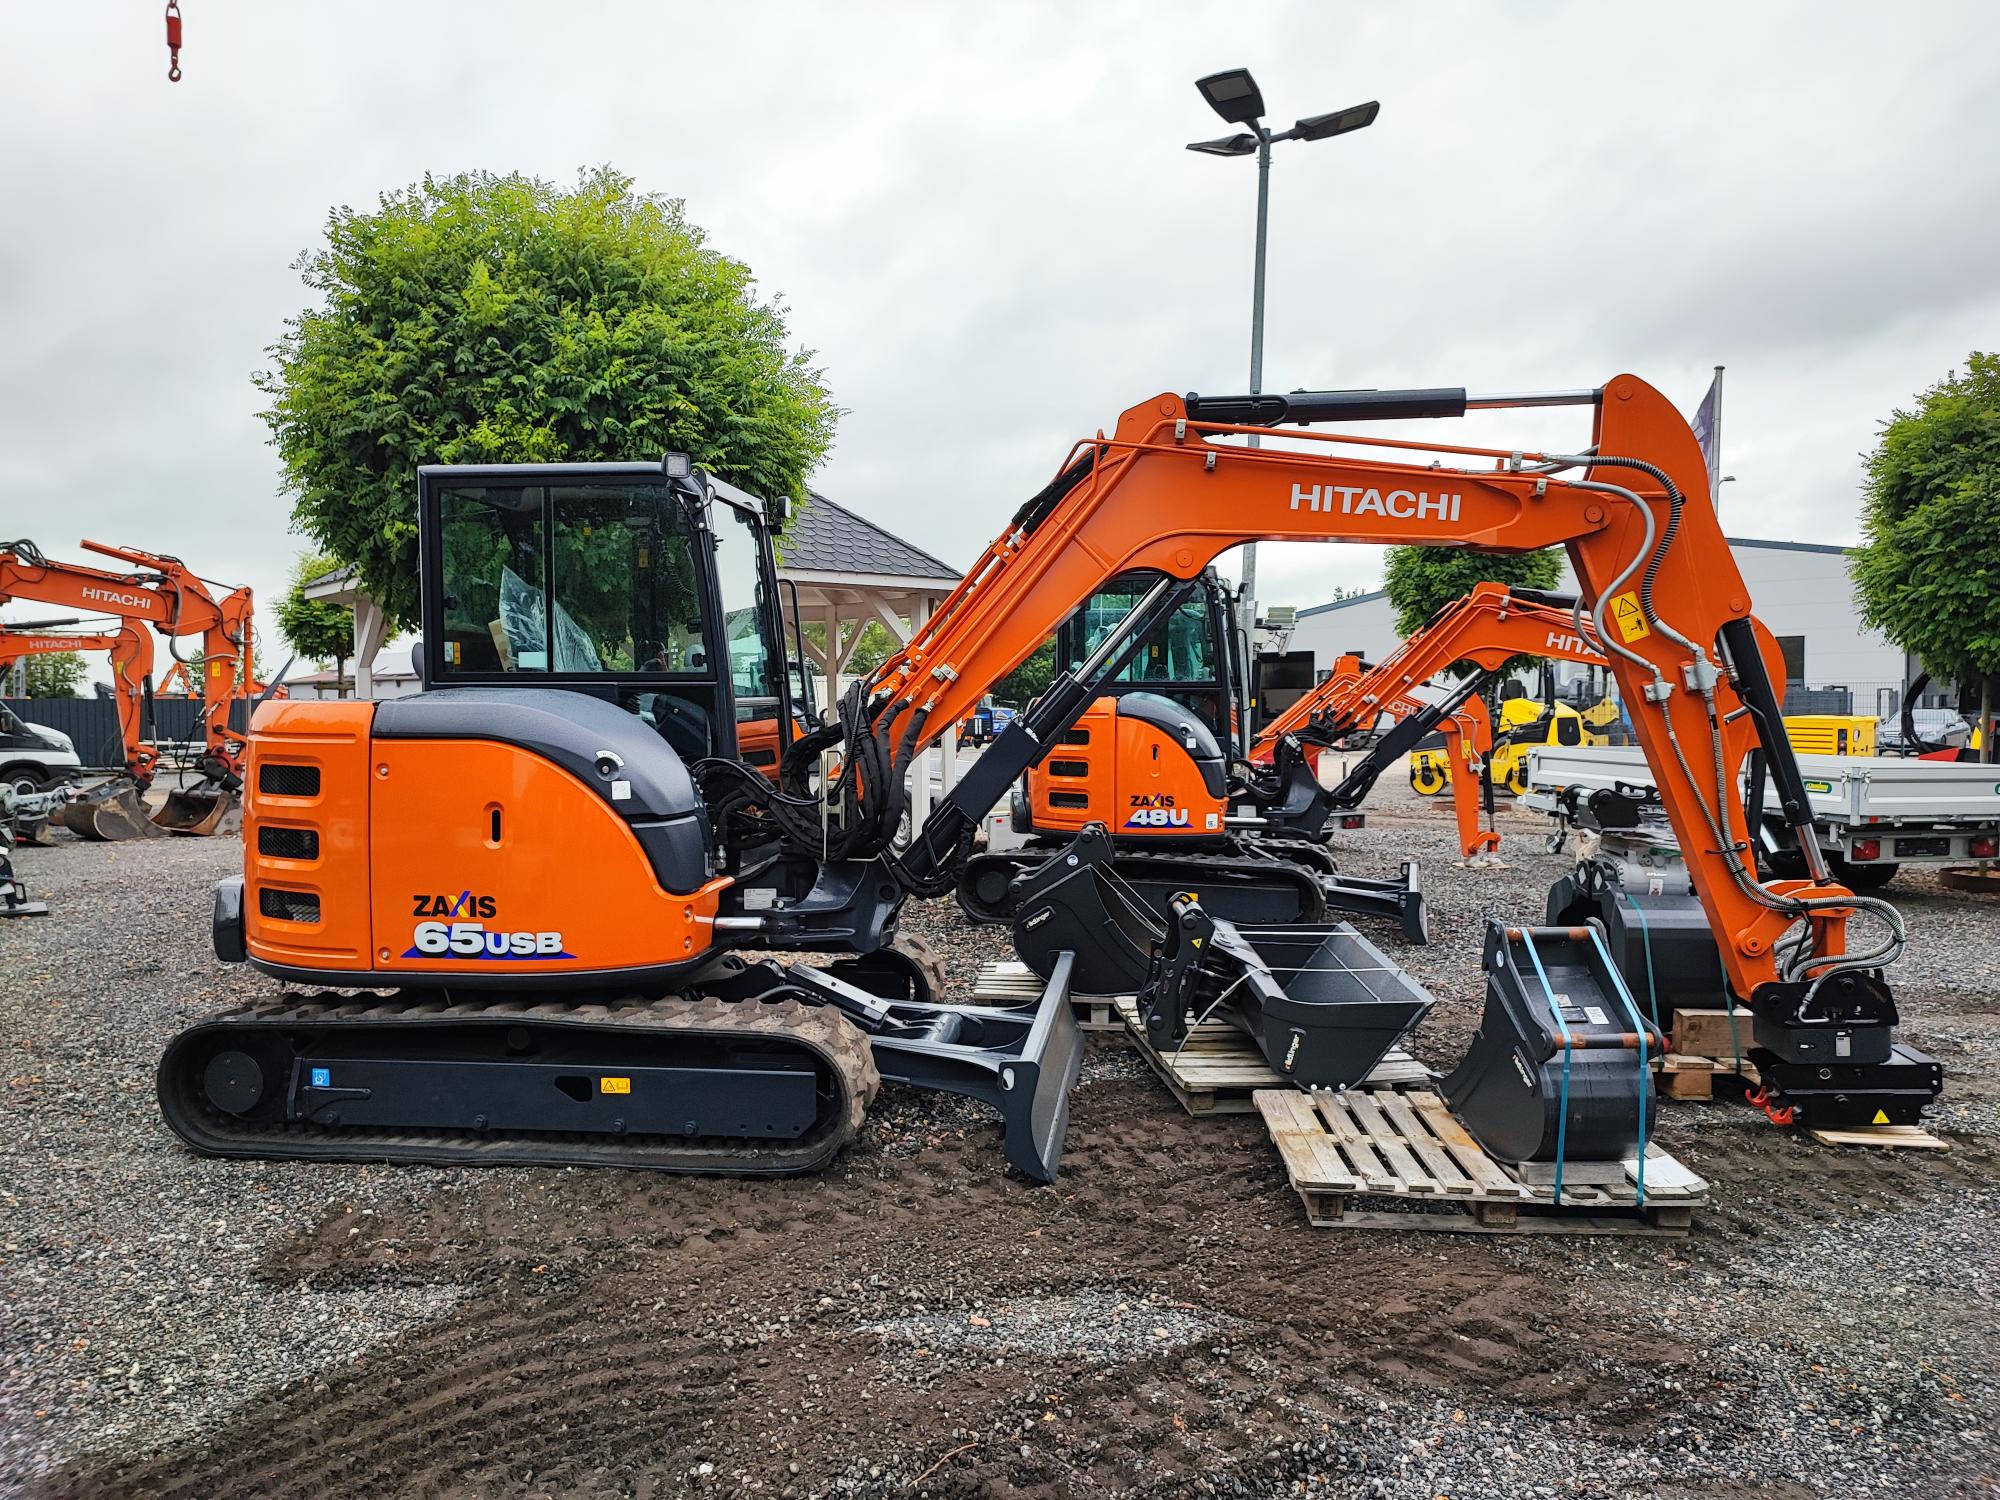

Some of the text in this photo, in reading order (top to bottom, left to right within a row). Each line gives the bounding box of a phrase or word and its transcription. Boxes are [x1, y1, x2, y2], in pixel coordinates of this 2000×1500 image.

[1289, 483, 1462, 522] HITACHI
[82, 587, 151, 609] HITACHI
[29, 639, 82, 649] HITACHI
[1130, 792, 1175, 808] ZAXIS
[1129, 808, 1189, 827] 48U
[412, 890, 497, 918] ZAXIS
